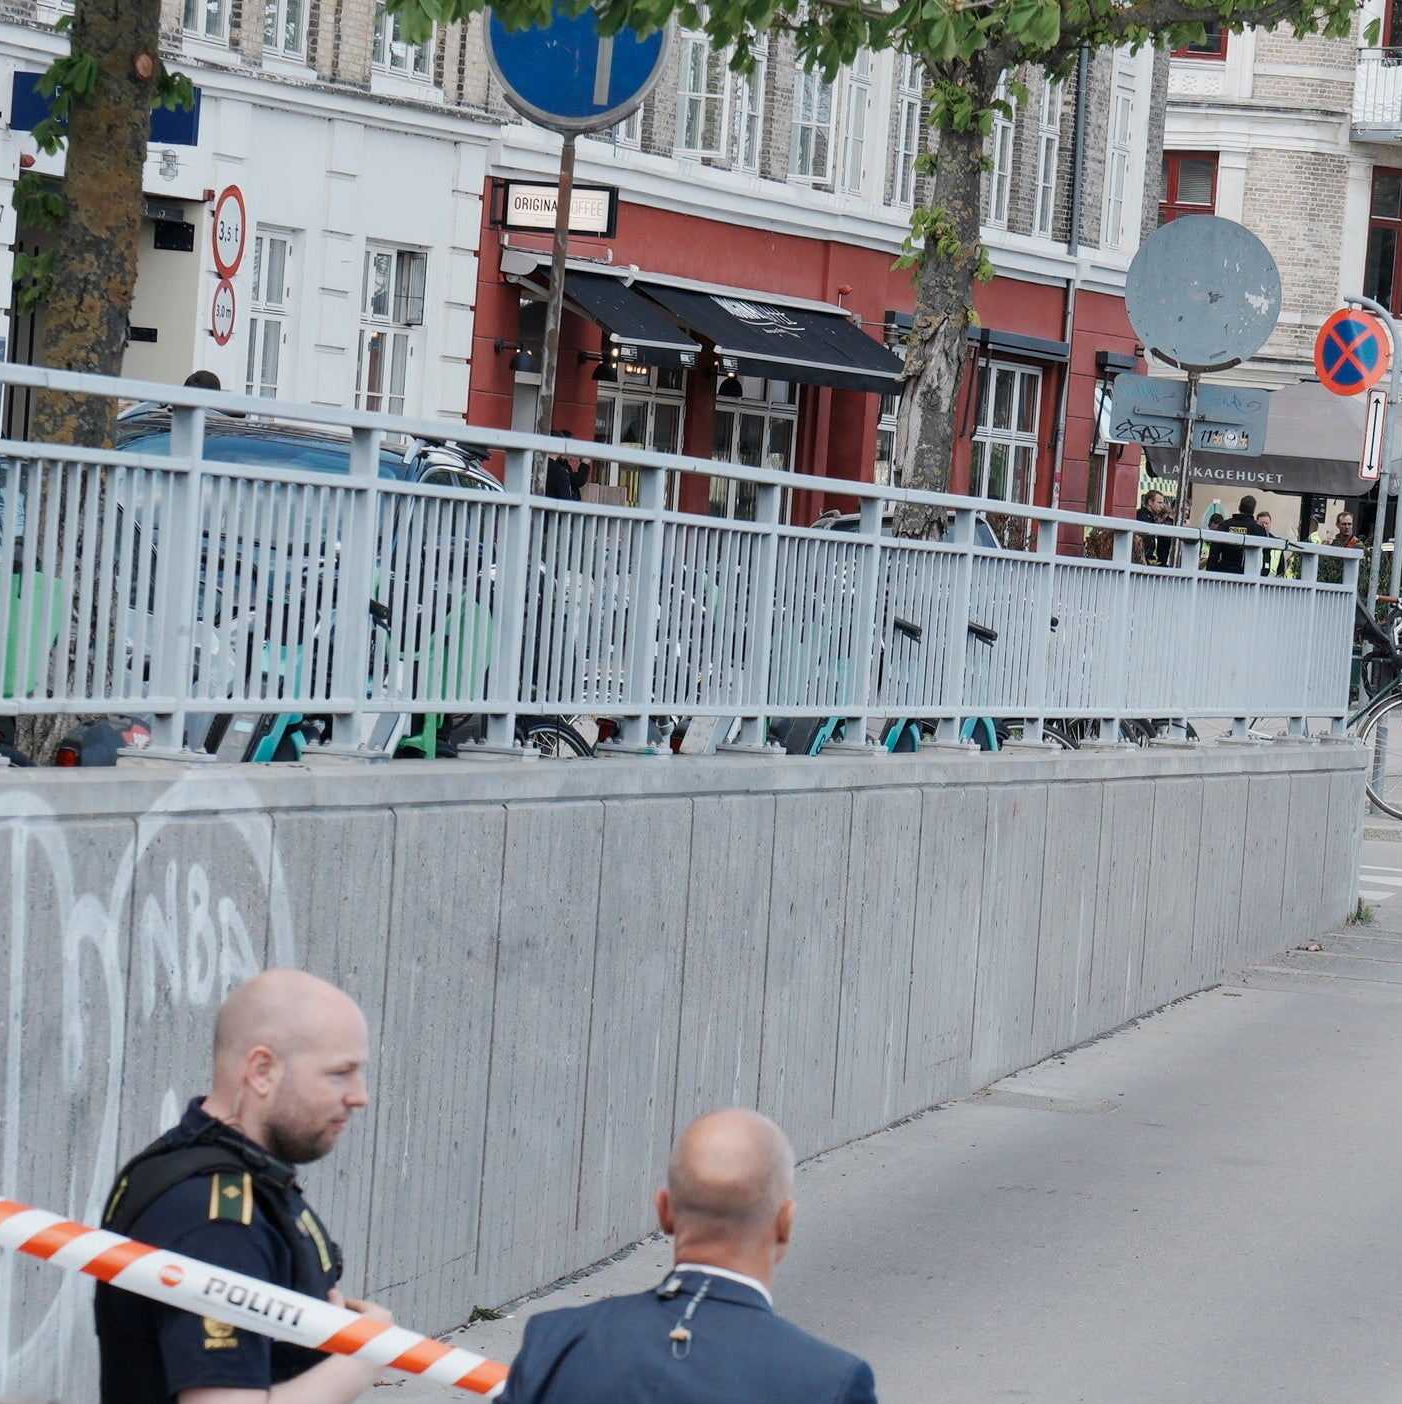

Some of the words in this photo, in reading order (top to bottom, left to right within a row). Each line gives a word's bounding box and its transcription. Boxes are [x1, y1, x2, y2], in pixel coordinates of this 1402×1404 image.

[514, 196, 557, 212] ORIGINA
[571, 200, 604, 217] OFFEE
[218, 220, 232, 243] 3,5
[234, 223, 239, 243] t
[215, 304, 226, 318] 3,0
[225, 307, 232, 319] m
[1162, 463, 1284, 484] LAKAGEHUSET
[203, 1276, 304, 1327] POLITI
